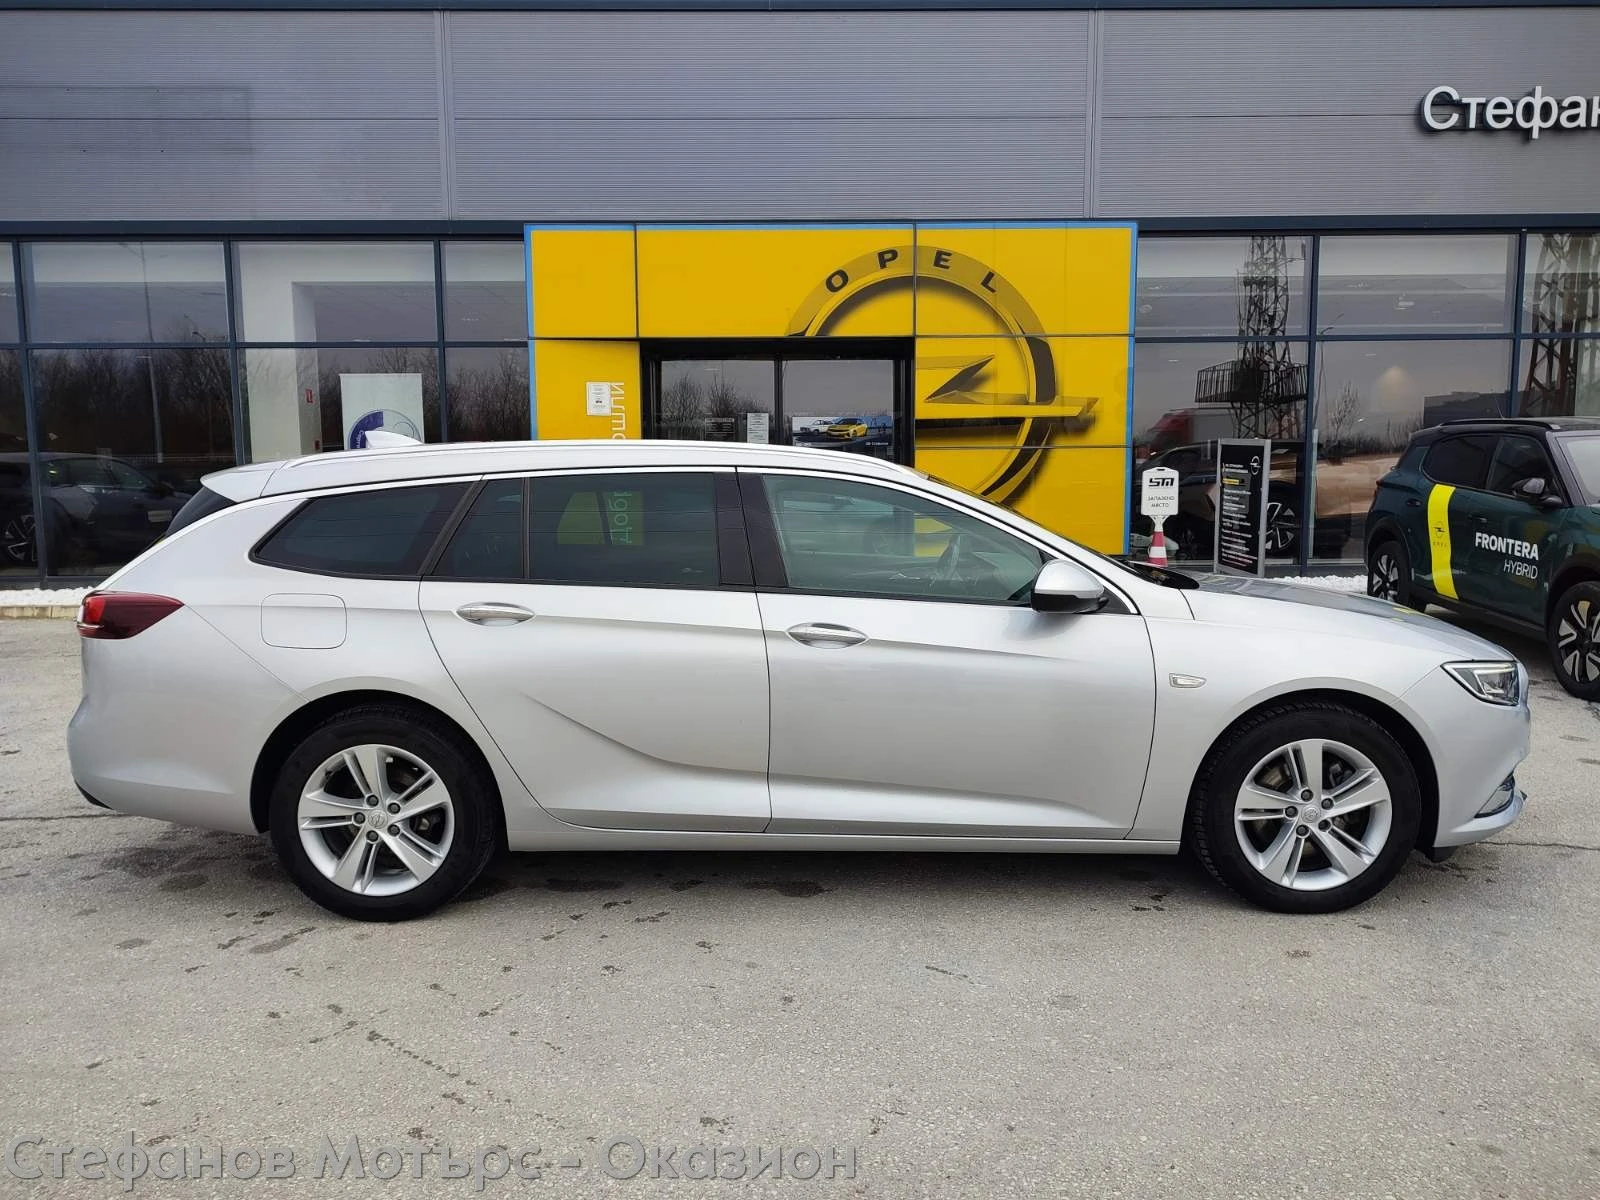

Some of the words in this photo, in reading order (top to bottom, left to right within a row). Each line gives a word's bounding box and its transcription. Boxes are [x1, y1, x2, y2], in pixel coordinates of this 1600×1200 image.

[825, 249, 997, 293] OPEL
[1475, 531, 1539, 561] FRONTERA
[1503, 559, 1538, 580] HYBRID
